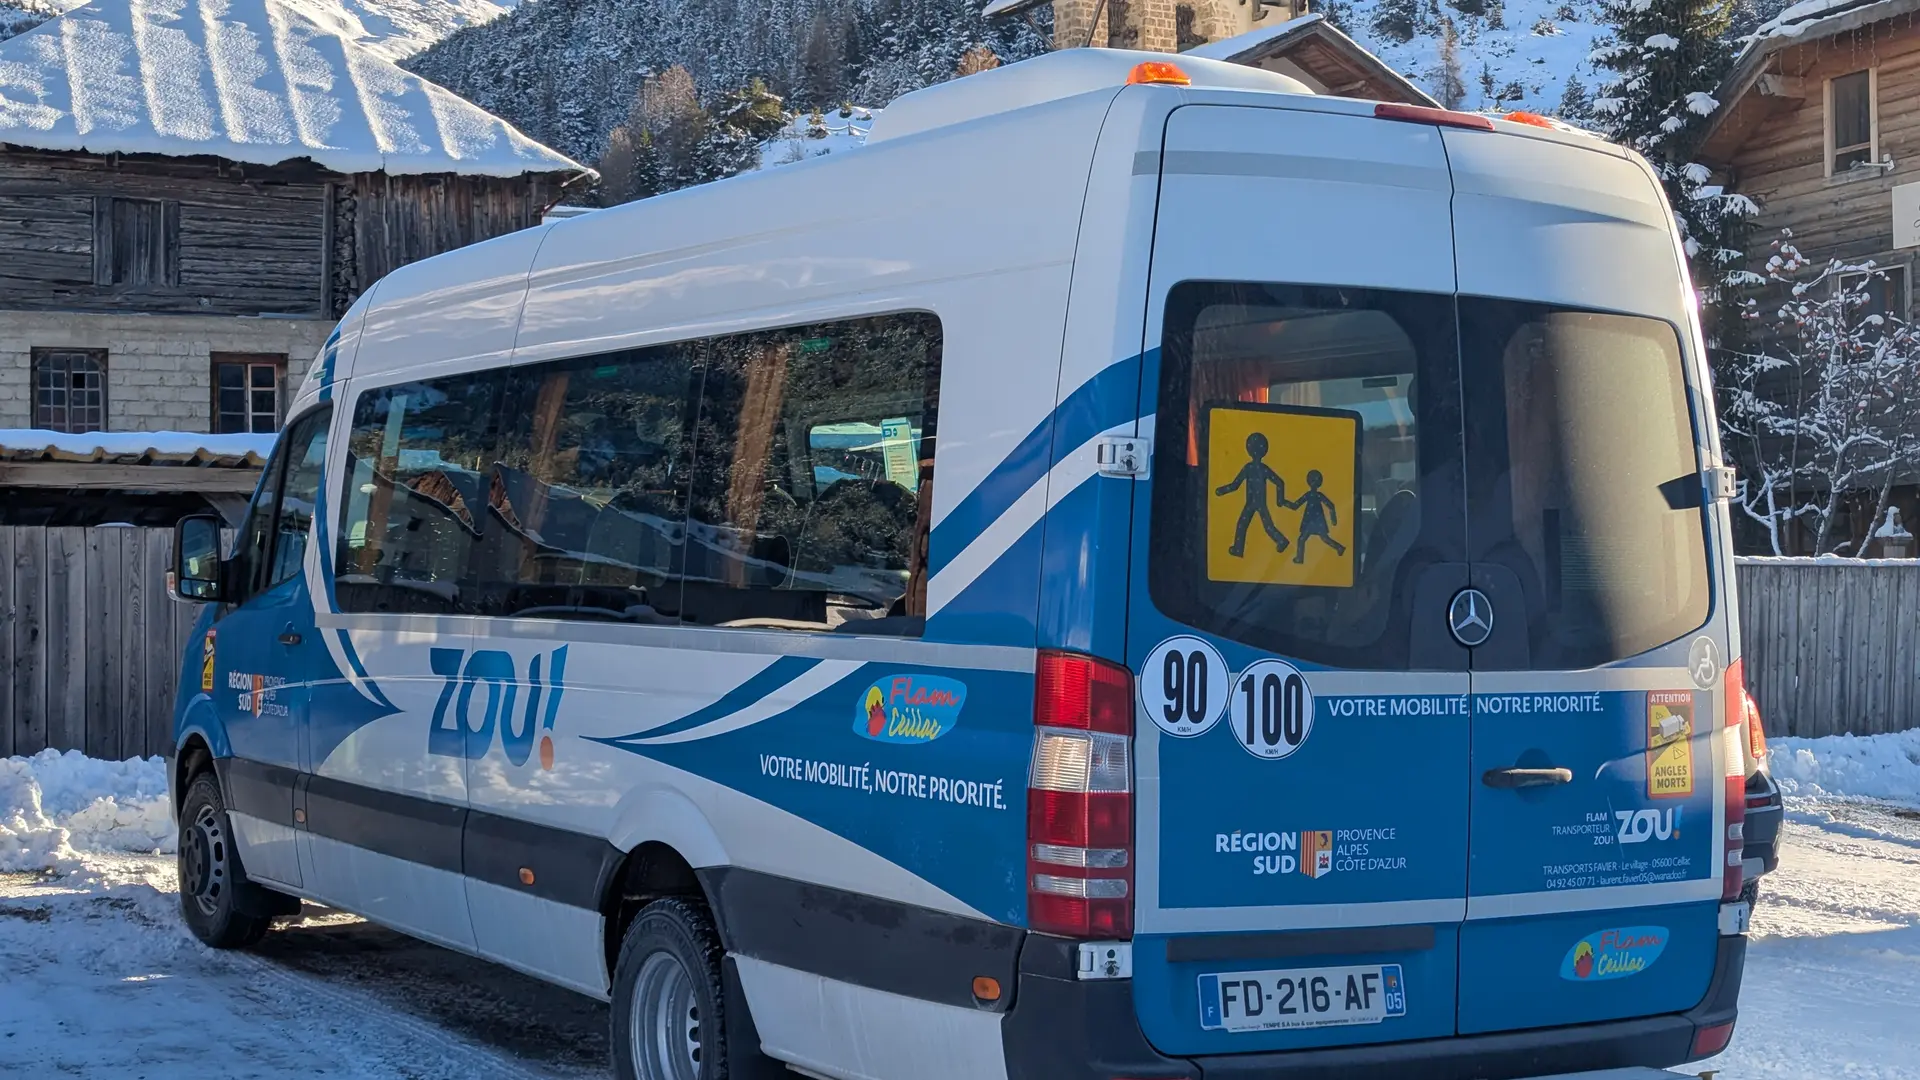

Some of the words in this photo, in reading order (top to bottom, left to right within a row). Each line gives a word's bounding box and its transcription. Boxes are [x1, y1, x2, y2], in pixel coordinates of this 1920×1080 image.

[228, 669, 253, 690] RÉGION
[1163, 649, 1208, 724] 90
[238, 693, 252, 711] SUD
[890, 677, 960, 707] Flam
[1651, 693, 1691, 703] ATTENTION
[428, 643, 569, 771] ZOU!
[1241, 673, 1304, 746] 100
[1328, 699, 1386, 717] VOTRE
[1476, 697, 1531, 714] NOTRE
[1534, 691, 1604, 713] PRIORITÉ.
[1655, 765, 1687, 777] ANGLES
[760, 753, 802, 780] VOTRE
[804, 761, 873, 794] MOBILITÉ,
[875, 769, 927, 798] NOTRE
[929, 778, 1007, 811] PRIORITÉ.
[1656, 777, 1686, 789] MORTS
[1586, 812, 1608, 822] FLAM
[1615, 804, 1684, 844] ZOU!
[1336, 828, 1396, 842] PROVENCE
[1552, 823, 1610, 836] TRANSPORTEUR
[1215, 829, 1297, 853] RÉGION
[1336, 843, 1369, 856] ALPES
[1593, 835, 1614, 846] ZOU!
[1253, 855, 1296, 875] SUD
[1336, 856, 1366, 872] CÔTE
[1368, 857, 1407, 870] D'AZUR
[1543, 863, 1593, 876] TRANSPORTS
[1593, 861, 1618, 872] FAVIER
[1651, 858, 1672, 868] 05600
[1600, 930, 1664, 952] Flam
[1207, 1006, 1214, 1018] F
[1221, 973, 1379, 1018] FD-216-AF
[1386, 992, 1402, 1010] 05
